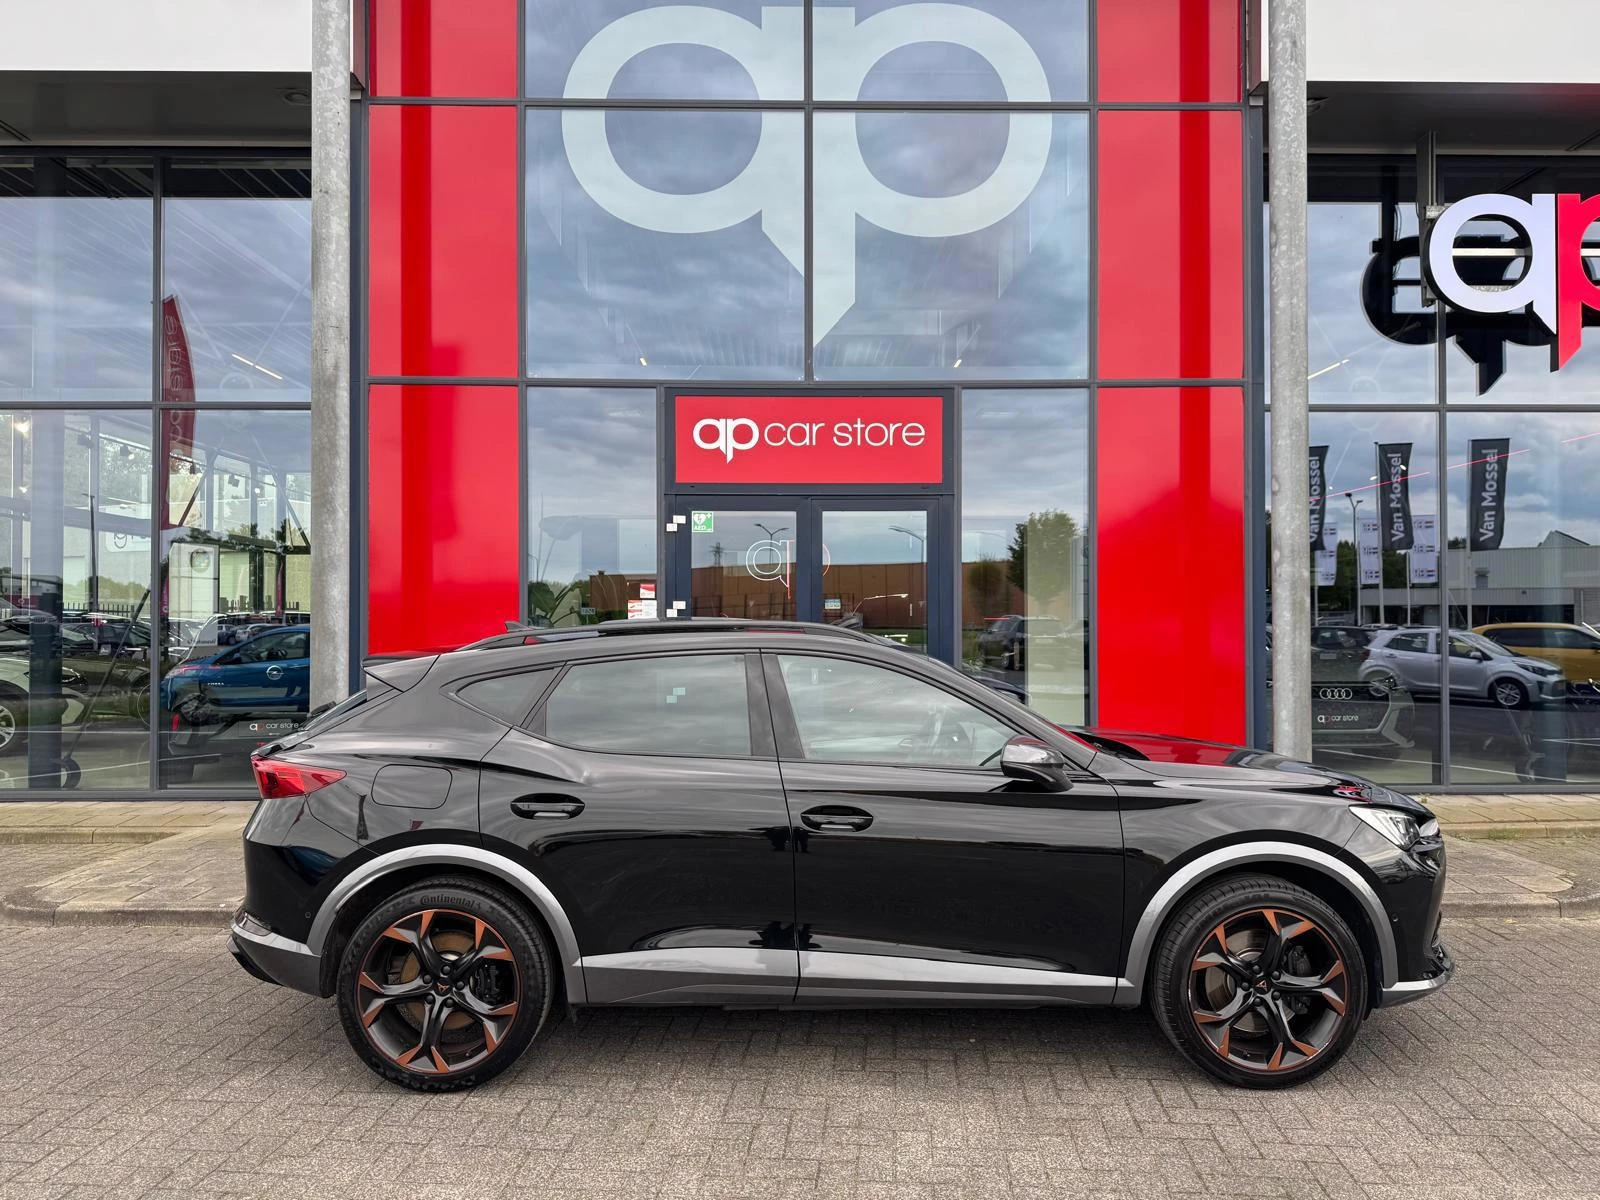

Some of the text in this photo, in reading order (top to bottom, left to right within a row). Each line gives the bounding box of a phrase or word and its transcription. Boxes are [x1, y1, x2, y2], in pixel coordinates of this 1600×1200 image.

[561, 2, 1052, 349] ap
[692, 417, 926, 464] ap car store
[1387, 452, 1405, 541] Van Mossel
[1479, 448, 1498, 541] Van Mossel
[419, 893, 476, 907] Continental
